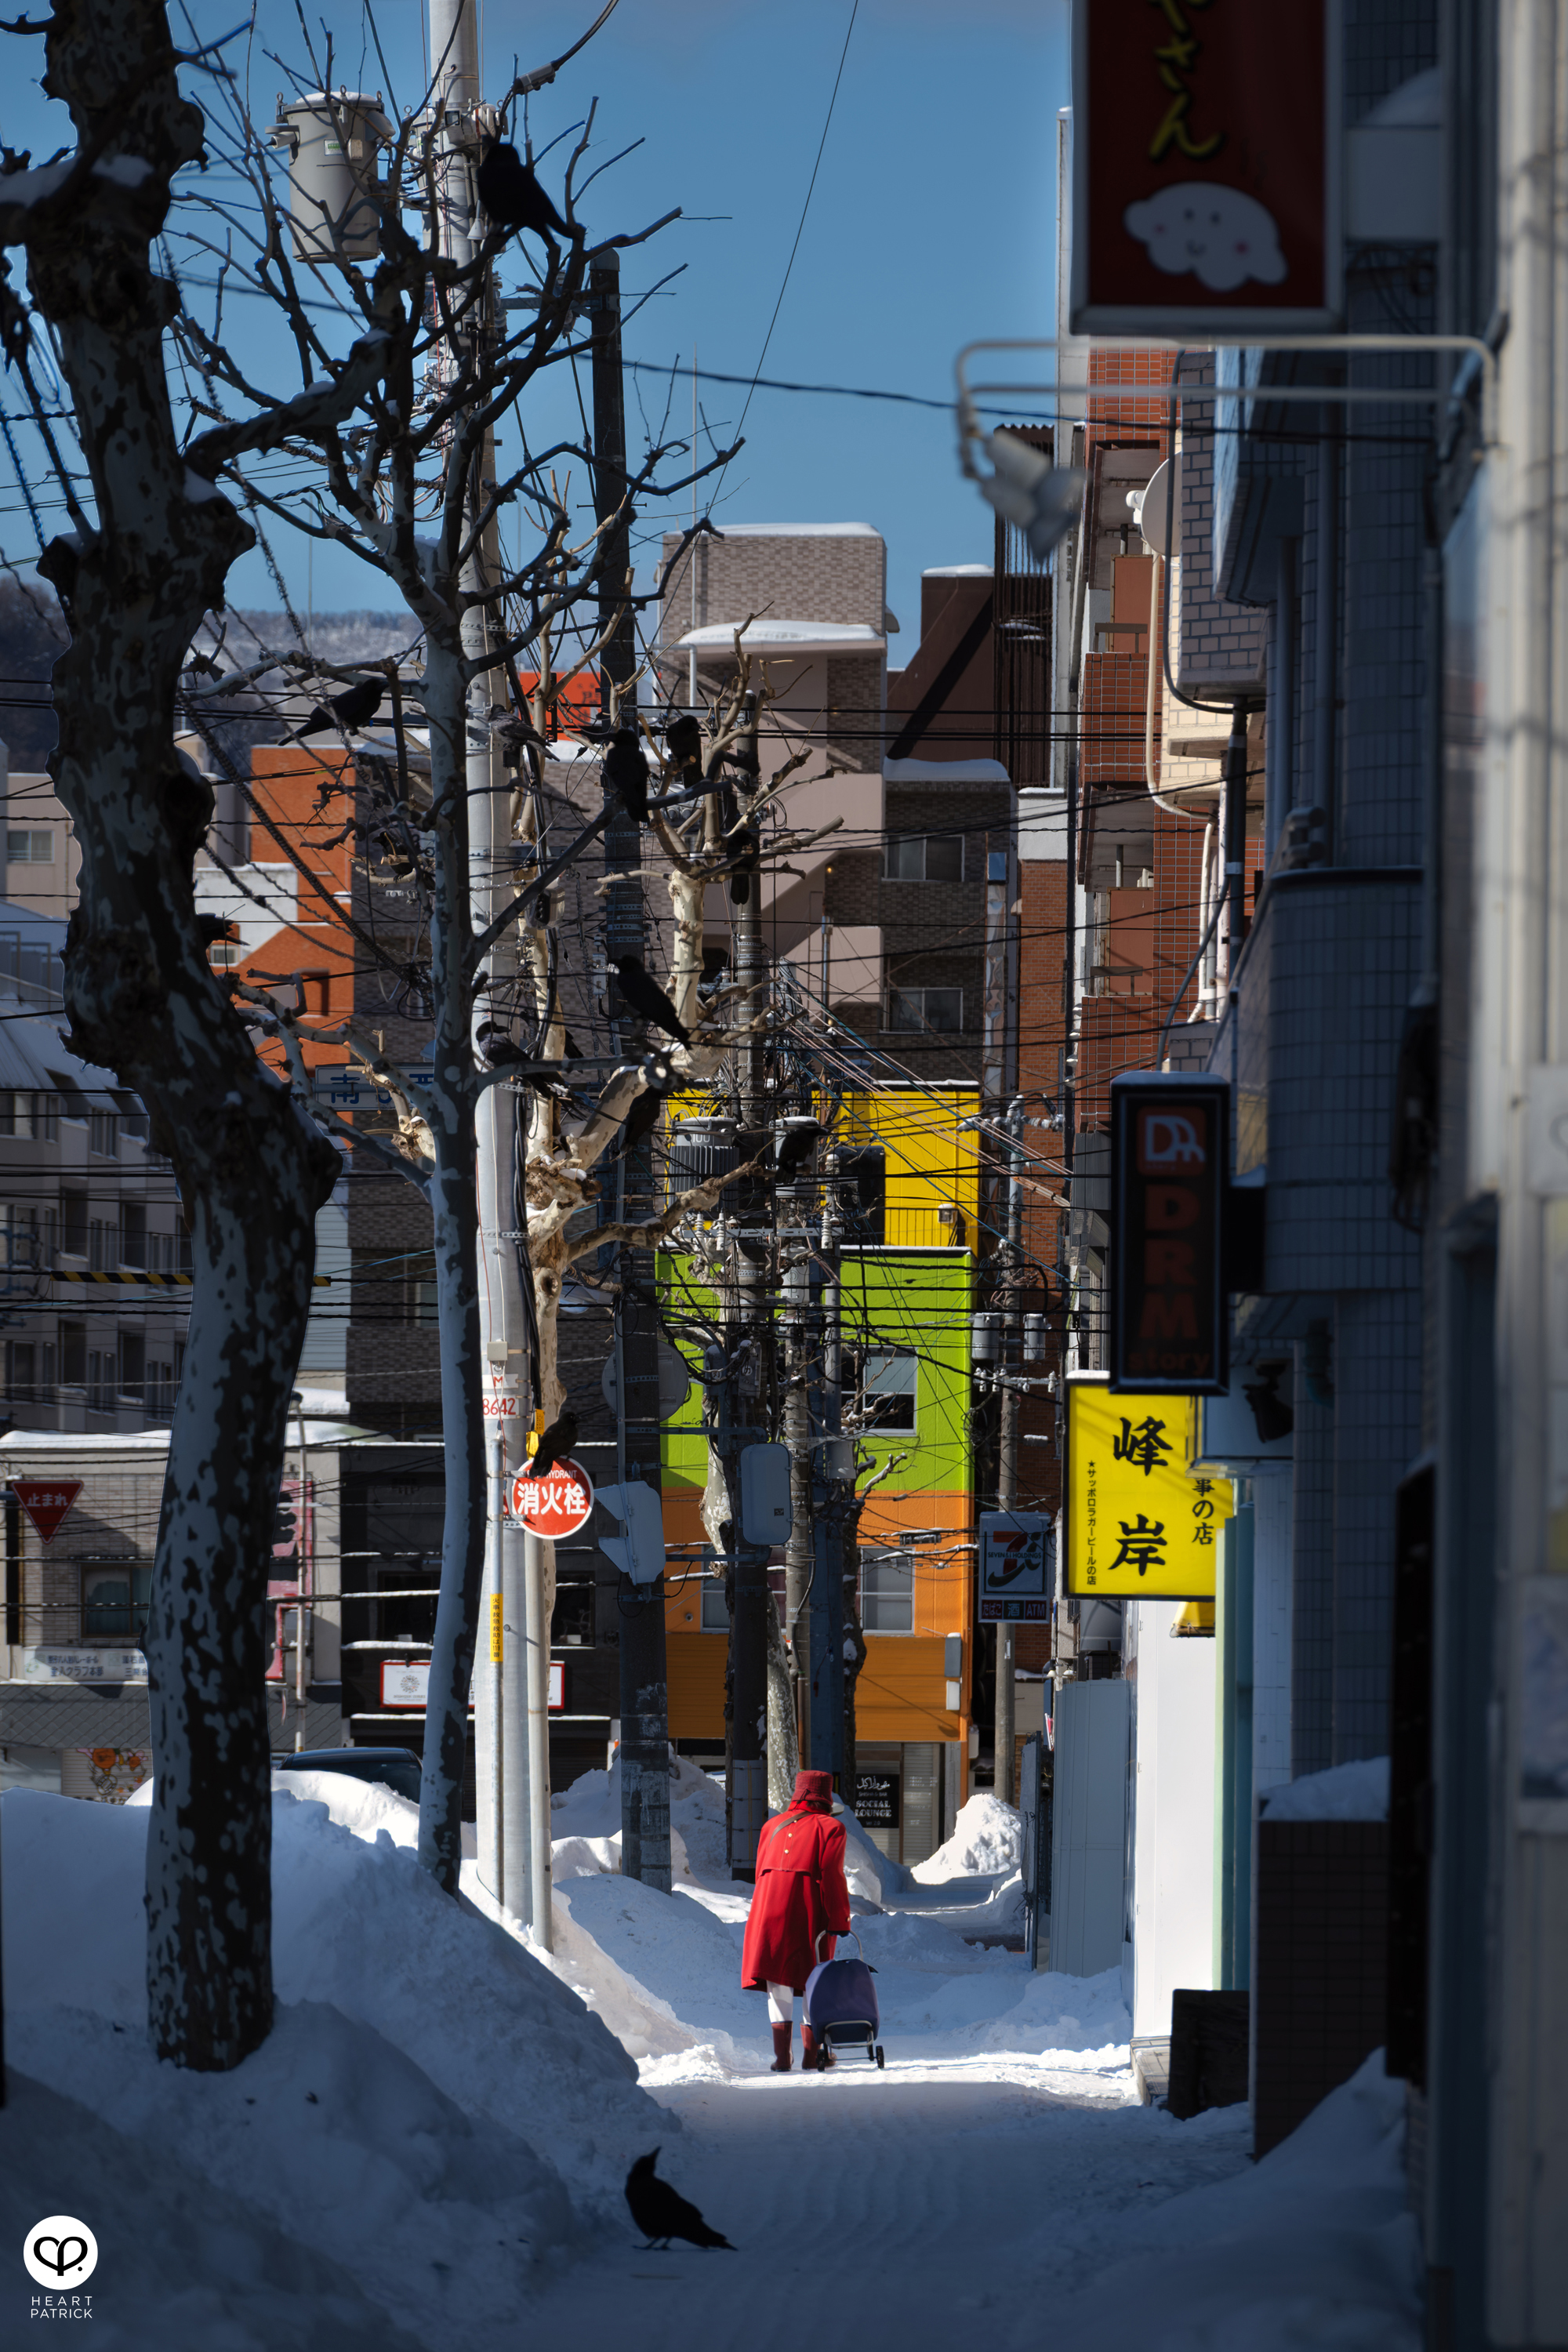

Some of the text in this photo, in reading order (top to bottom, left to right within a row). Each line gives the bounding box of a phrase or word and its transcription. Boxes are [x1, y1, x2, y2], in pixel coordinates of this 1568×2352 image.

[1127, 1348, 1210, 1376] story
[483, 1397, 517, 1416] 8642
[26, 1493, 69, 1507] 止まれ
[517, 1482, 587, 1515] 消火栓
[1108, 1415, 1174, 1577] 峰岸
[1086, 1468, 1097, 1585] サッポロラガービールの店
[982, 1602, 1002, 1616] たばこ
[1007, 1602, 1020, 1617] 酒
[1026, 1603, 1045, 1617] ATM
[855, 1809, 892, 1817] LOUNGE
